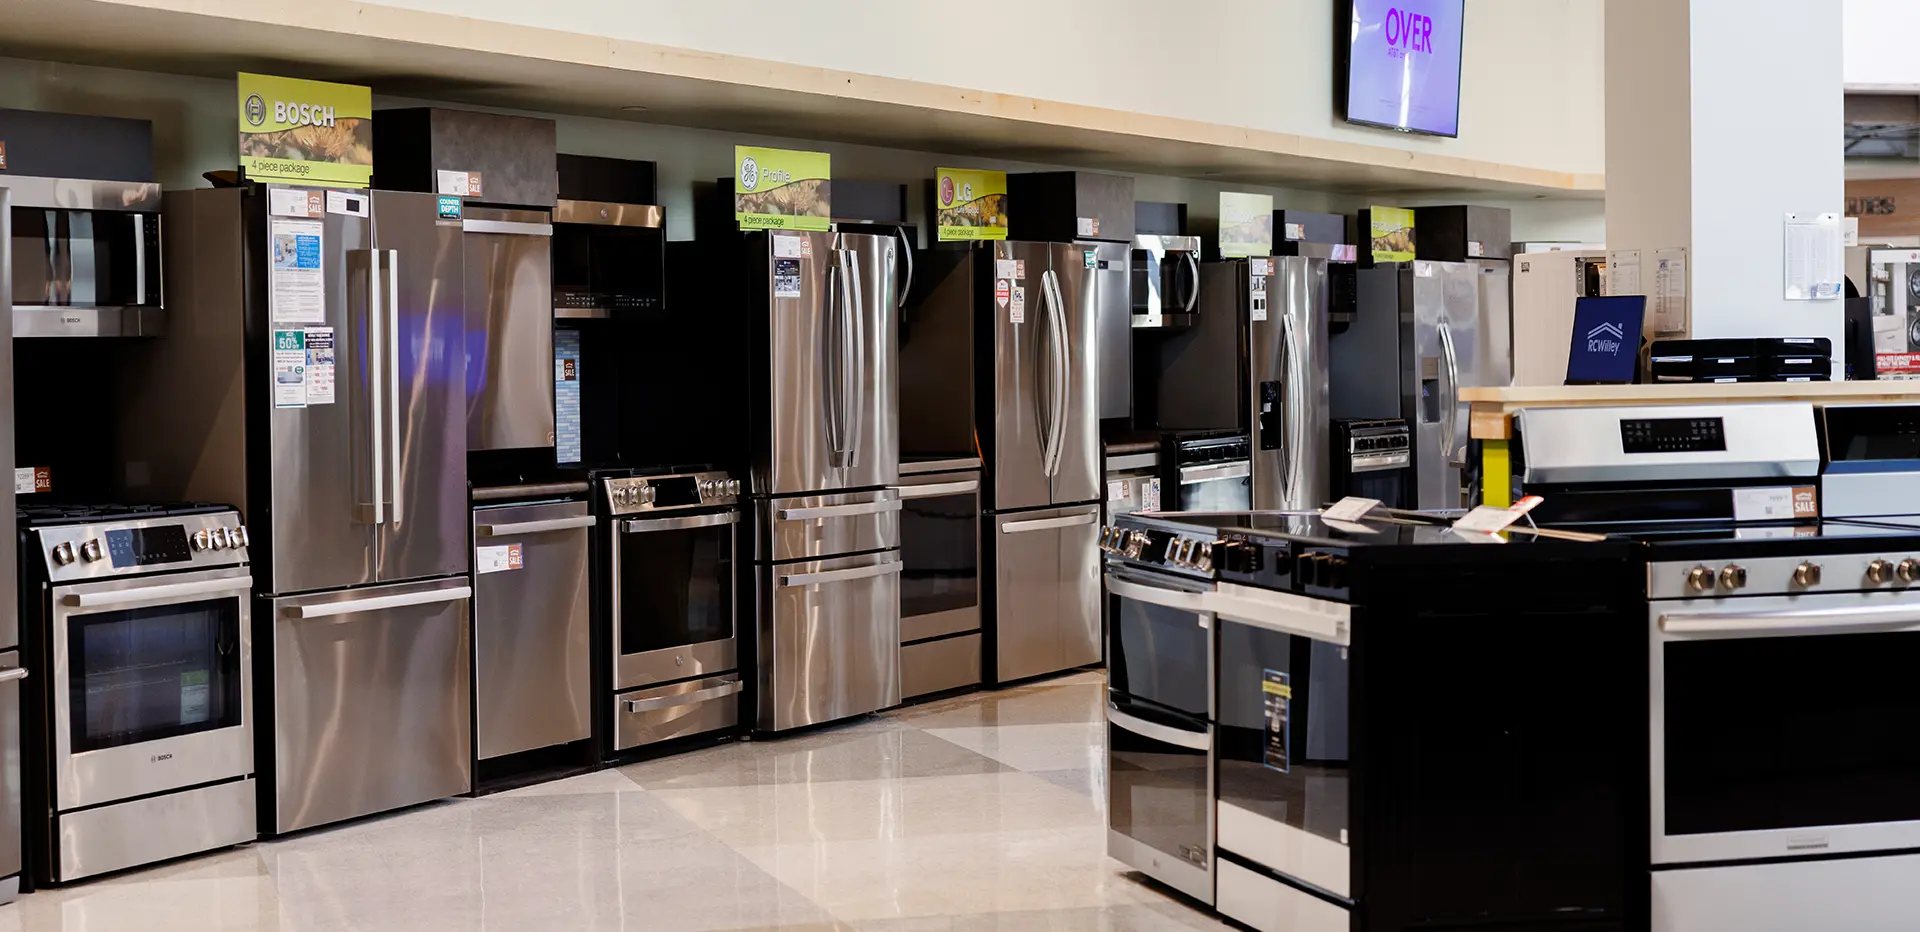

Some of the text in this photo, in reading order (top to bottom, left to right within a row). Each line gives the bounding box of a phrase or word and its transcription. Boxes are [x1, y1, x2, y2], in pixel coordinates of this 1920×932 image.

[1385, 7, 1432, 54] OVER
[274, 101, 335, 127] BOSCH
[252, 160, 310, 176] 4 piece package
[762, 167, 791, 182] Profile
[469, 184, 480, 192] SALE
[956, 183, 972, 201] LG
[308, 203, 322, 213] SALE
[441, 205, 459, 213] DEPTH
[748, 216, 762, 225] piece
[763, 216, 785, 227] package
[958, 229, 974, 237] package
[279, 337, 298, 349] 50%
[1588, 339, 1620, 356] RCWilley
[565, 369, 575, 377] SALE
[36, 479, 50, 488] SALE
[1795, 501, 1815, 513] SALE
[510, 557, 522, 565] SALE
